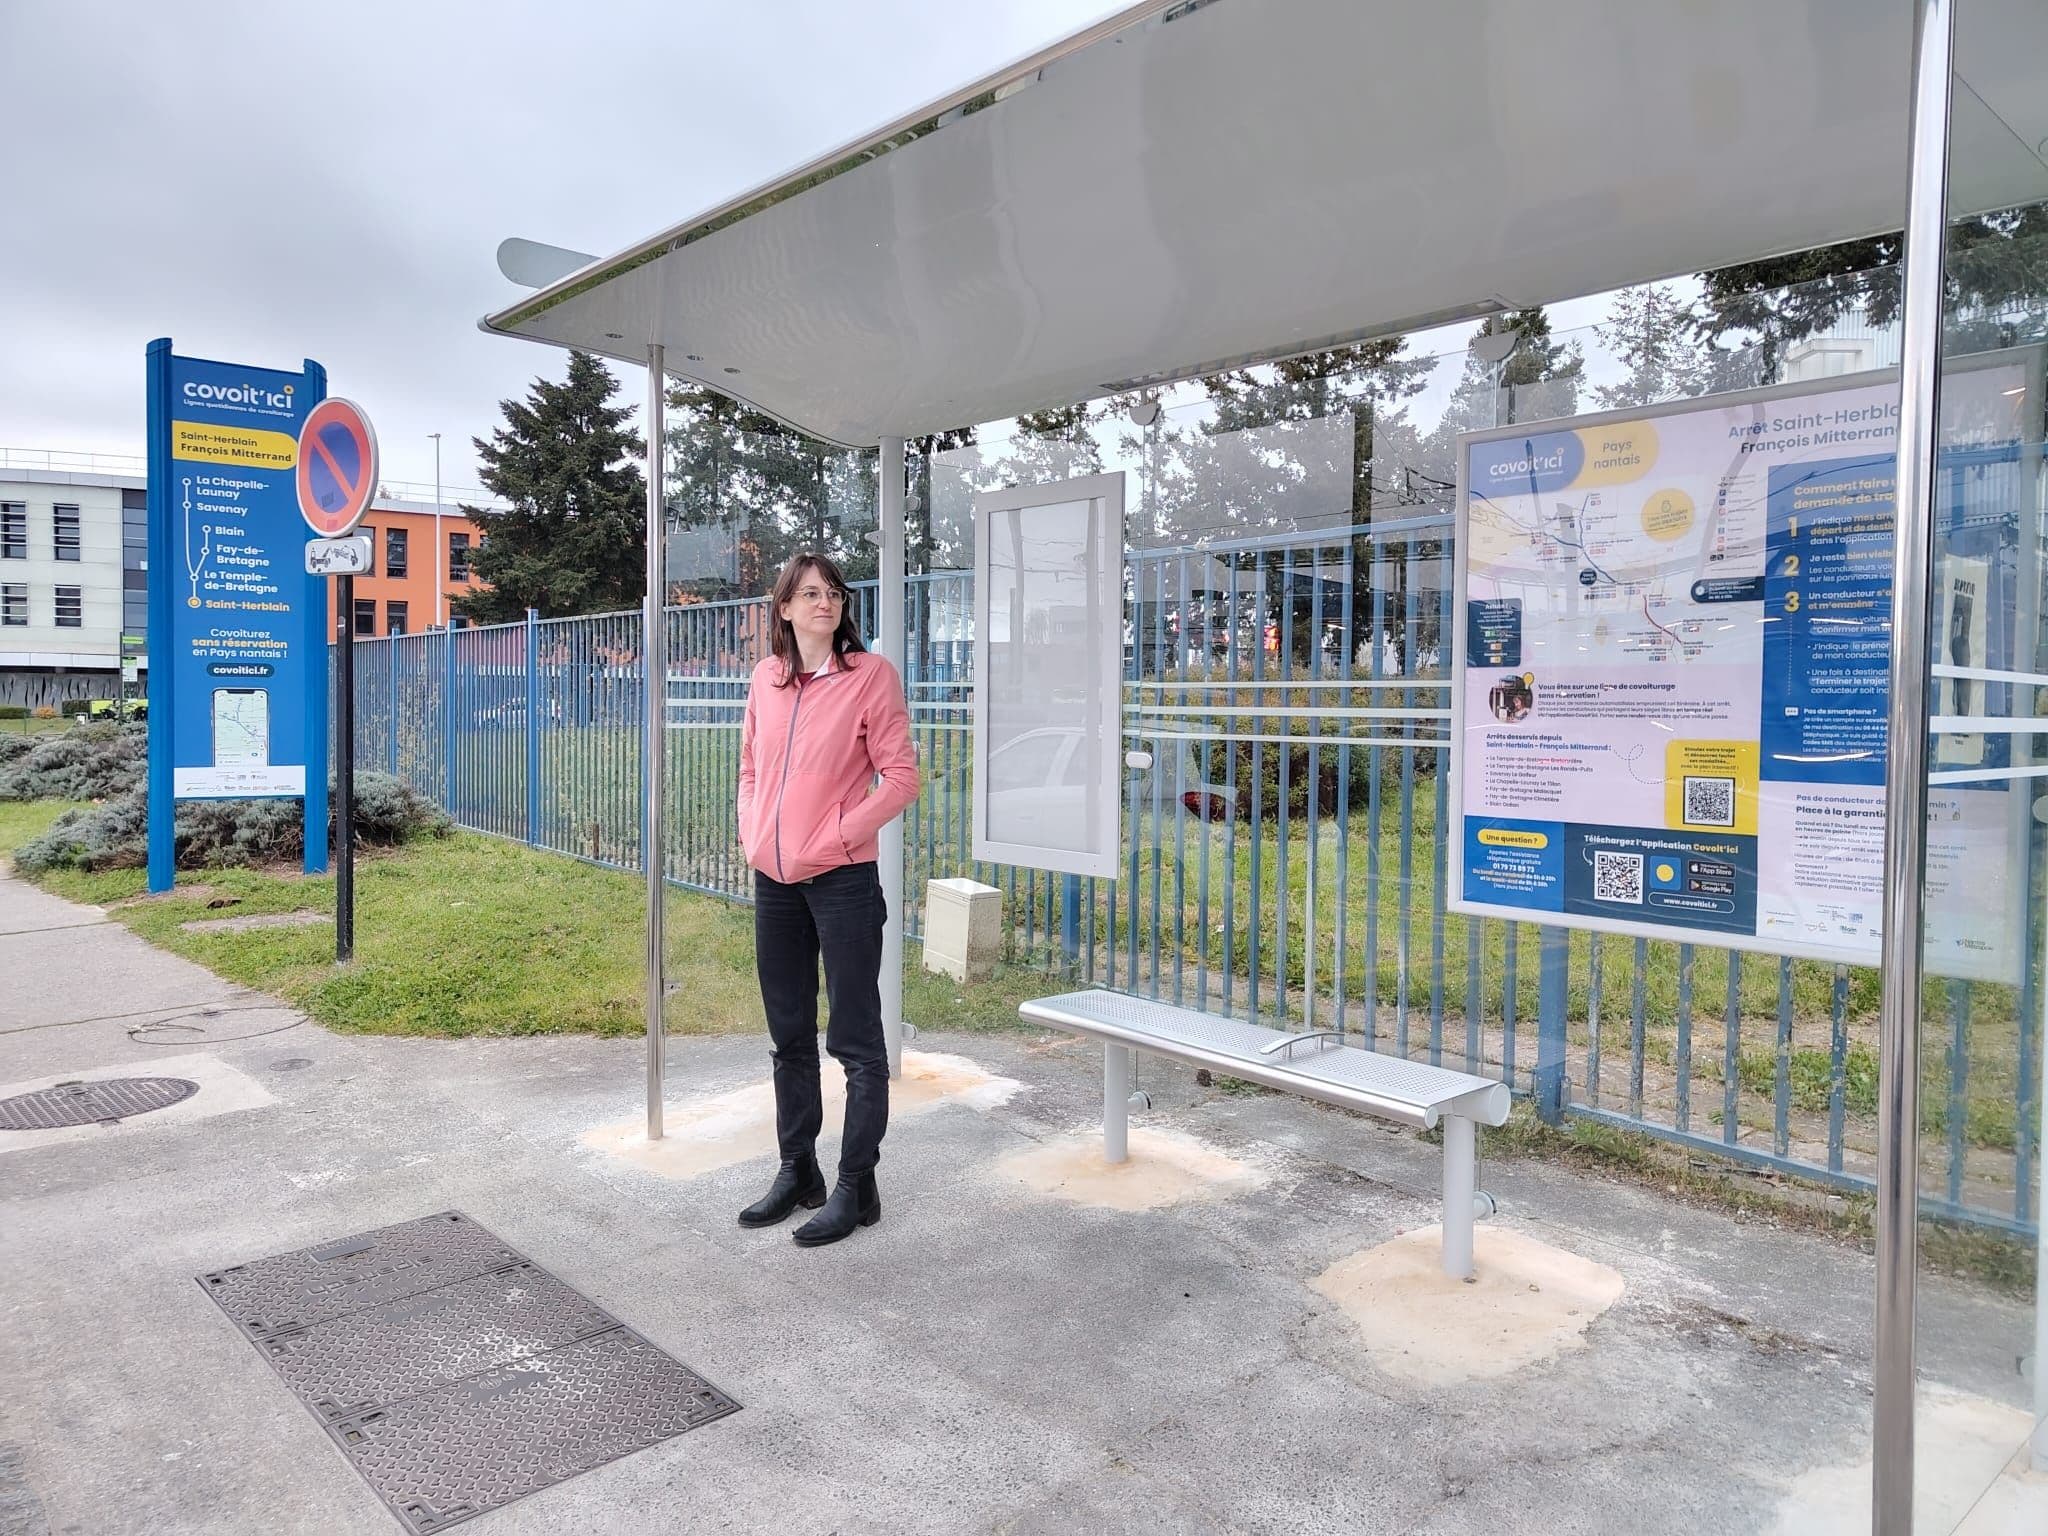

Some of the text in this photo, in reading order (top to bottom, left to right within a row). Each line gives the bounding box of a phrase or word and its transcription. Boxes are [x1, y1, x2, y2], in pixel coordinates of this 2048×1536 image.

[1728, 422, 1768, 439] Arrêt
[180, 431, 258, 447] Saint-Herblain
[1741, 424, 1898, 454] François Mitterran
[180, 443, 292, 462] François Mitterrand
[1602, 439, 1633, 454] Pays
[1593, 453, 1641, 469] nantais
[196, 475, 270, 490] La Chapelle-
[1794, 478, 1889, 496] Comment faire
[196, 487, 241, 500] Launay
[1793, 494, 1853, 510] demande
[1855, 493, 1873, 504] de
[196, 502, 249, 517] Savenay
[1810, 513, 1874, 527] J'indique mes
[215, 526, 245, 537] Blain
[1788, 515, 1798, 538] 1
[1810, 526, 1842, 537] départ
[1853, 525, 1866, 533] de
[1810, 538, 1834, 546] dans
[216, 544, 265, 556] Fay-de-
[216, 555, 270, 568] Bretagne
[1809, 551, 1868, 562] Je reste bien
[1784, 555, 1799, 576] 2
[1809, 563, 1877, 574] Les conducteurs
[204, 570, 268, 584] Le Temple-
[1809, 575, 1822, 583] sur
[204, 581, 278, 595] de-Bretagne
[1808, 590, 1875, 600] Un conducteur
[205, 599, 290, 612] Saint-Herblain
[1784, 591, 1800, 612] 3
[209, 628, 271, 639] Covoiturez
[191, 638, 288, 649] sans réservation
[1812, 642, 1849, 652] J'indique
[192, 647, 282, 660] en Pays nantais
[1812, 652, 1824, 660] de
[213, 665, 269, 675] covoitici.fr
[1811, 668, 1828, 676] Une
[1829, 667, 1843, 676] fois
[1538, 683, 1555, 691] Vous
[1556, 683, 1571, 691] êtes
[1585, 683, 1599, 691] une
[1629, 682, 1676, 691] covoiturage
[1854, 677, 1862, 685] le
[1810, 686, 1875, 695] conducteur soit
[1803, 706, 1817, 715] Pas
[1818, 707, 1827, 715] de
[1827, 707, 1871, 717] smartphone
[1507, 733, 1538, 741] desservis
[1539, 734, 1562, 742] depuis
[1539, 742, 1569, 751] François
[1796, 794, 1875, 805] Pas de conducteur
[1796, 805, 1823, 815] Place
[1824, 806, 1831, 816] à
[1833, 807, 1843, 817] la
[1500, 835, 1532, 844] question
[1584, 835, 1739, 854] Téléchargez l'application Covoit'ici
[1663, 897, 1718, 910] www.covoitici.fr
